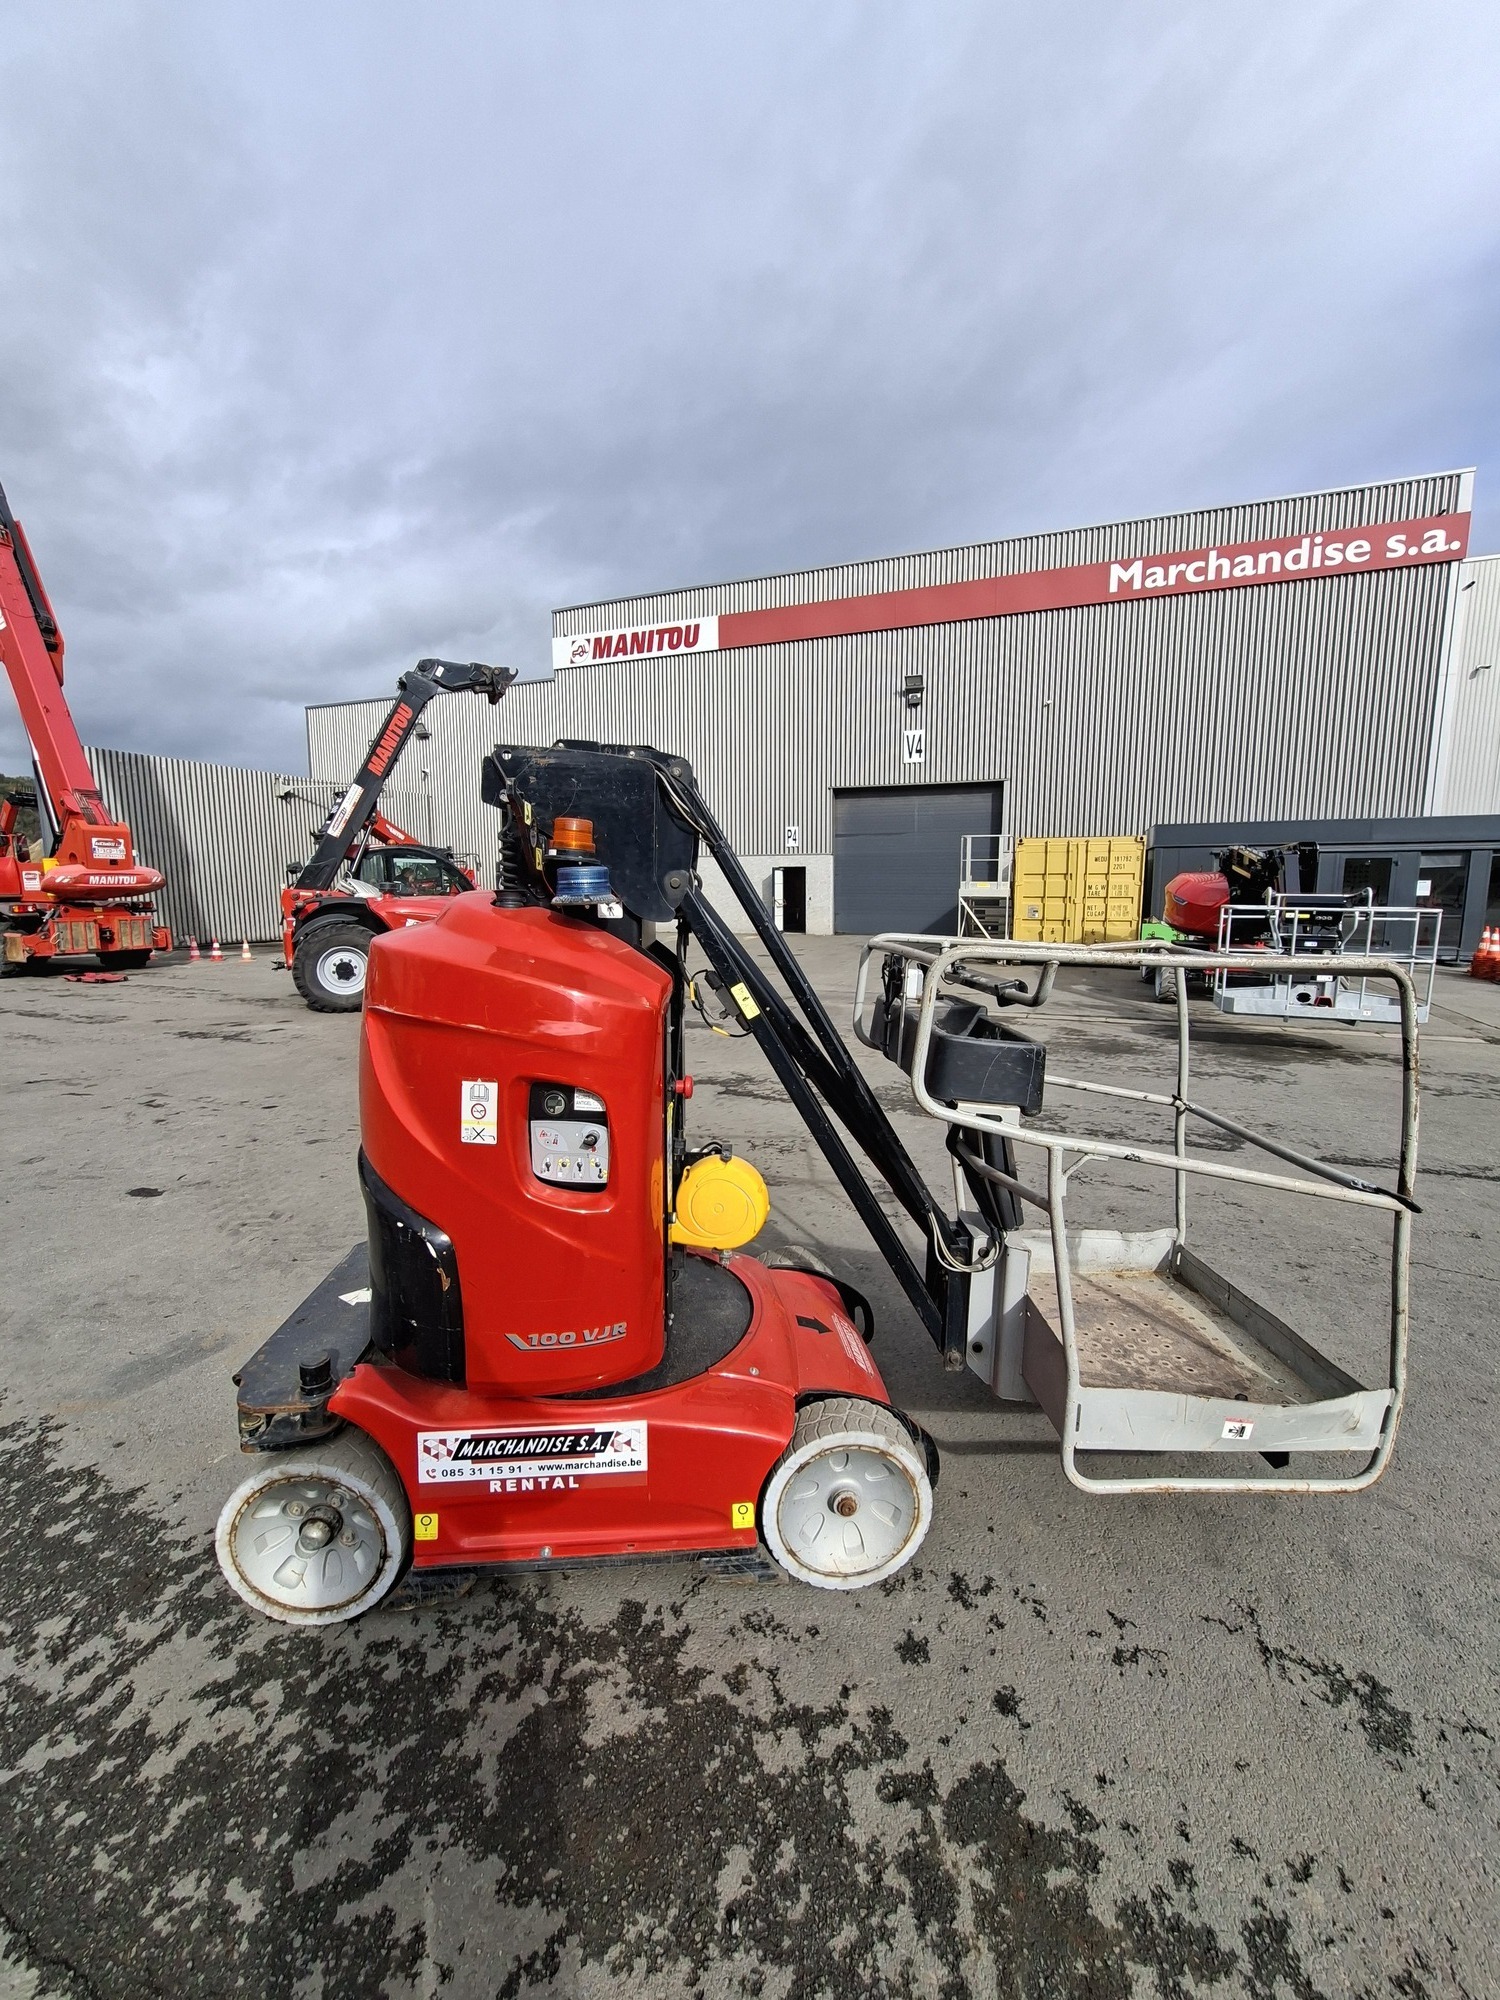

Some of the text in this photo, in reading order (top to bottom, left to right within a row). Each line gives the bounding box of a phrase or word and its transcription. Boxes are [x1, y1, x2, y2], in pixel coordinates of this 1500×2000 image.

[1108, 527, 1462, 593] Marchandise s.a.
[592, 623, 700, 660] MANITOU
[367, 702, 413, 777] MANITOU
[906, 734, 923, 759] V4
[787, 829, 797, 844] P4
[89, 875, 137, 885] MANITOU
[528, 1321, 627, 1346] 100 VJR
[458, 1435, 606, 1458] MARCHANDISE S.A.
[441, 1458, 642, 1478] 085 31 15 91 www.marchandise.be
[489, 1476, 580, 1493] RENTAL
